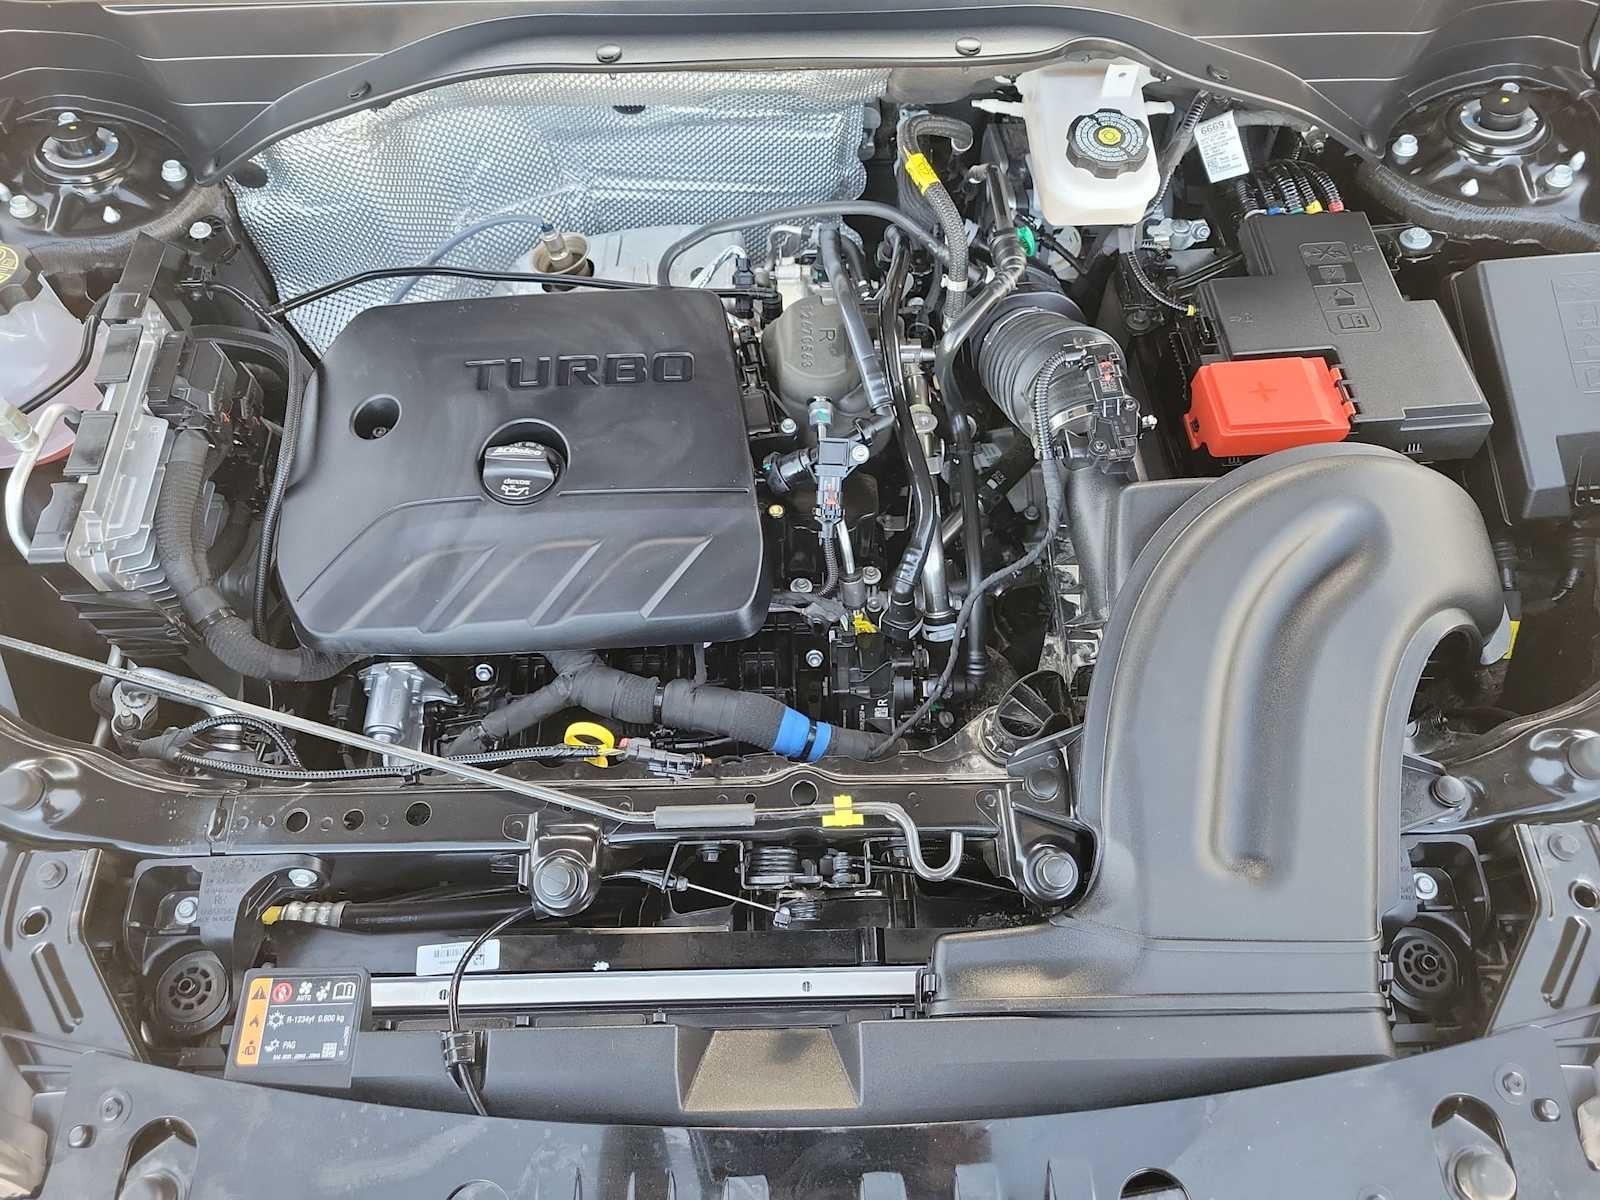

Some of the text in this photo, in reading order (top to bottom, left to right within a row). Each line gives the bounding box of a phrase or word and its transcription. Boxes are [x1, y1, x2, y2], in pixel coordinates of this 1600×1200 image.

[819, 327, 837, 342] R
[464, 351, 695, 391] TURBO
[296, 994, 312, 1002] AUTO
